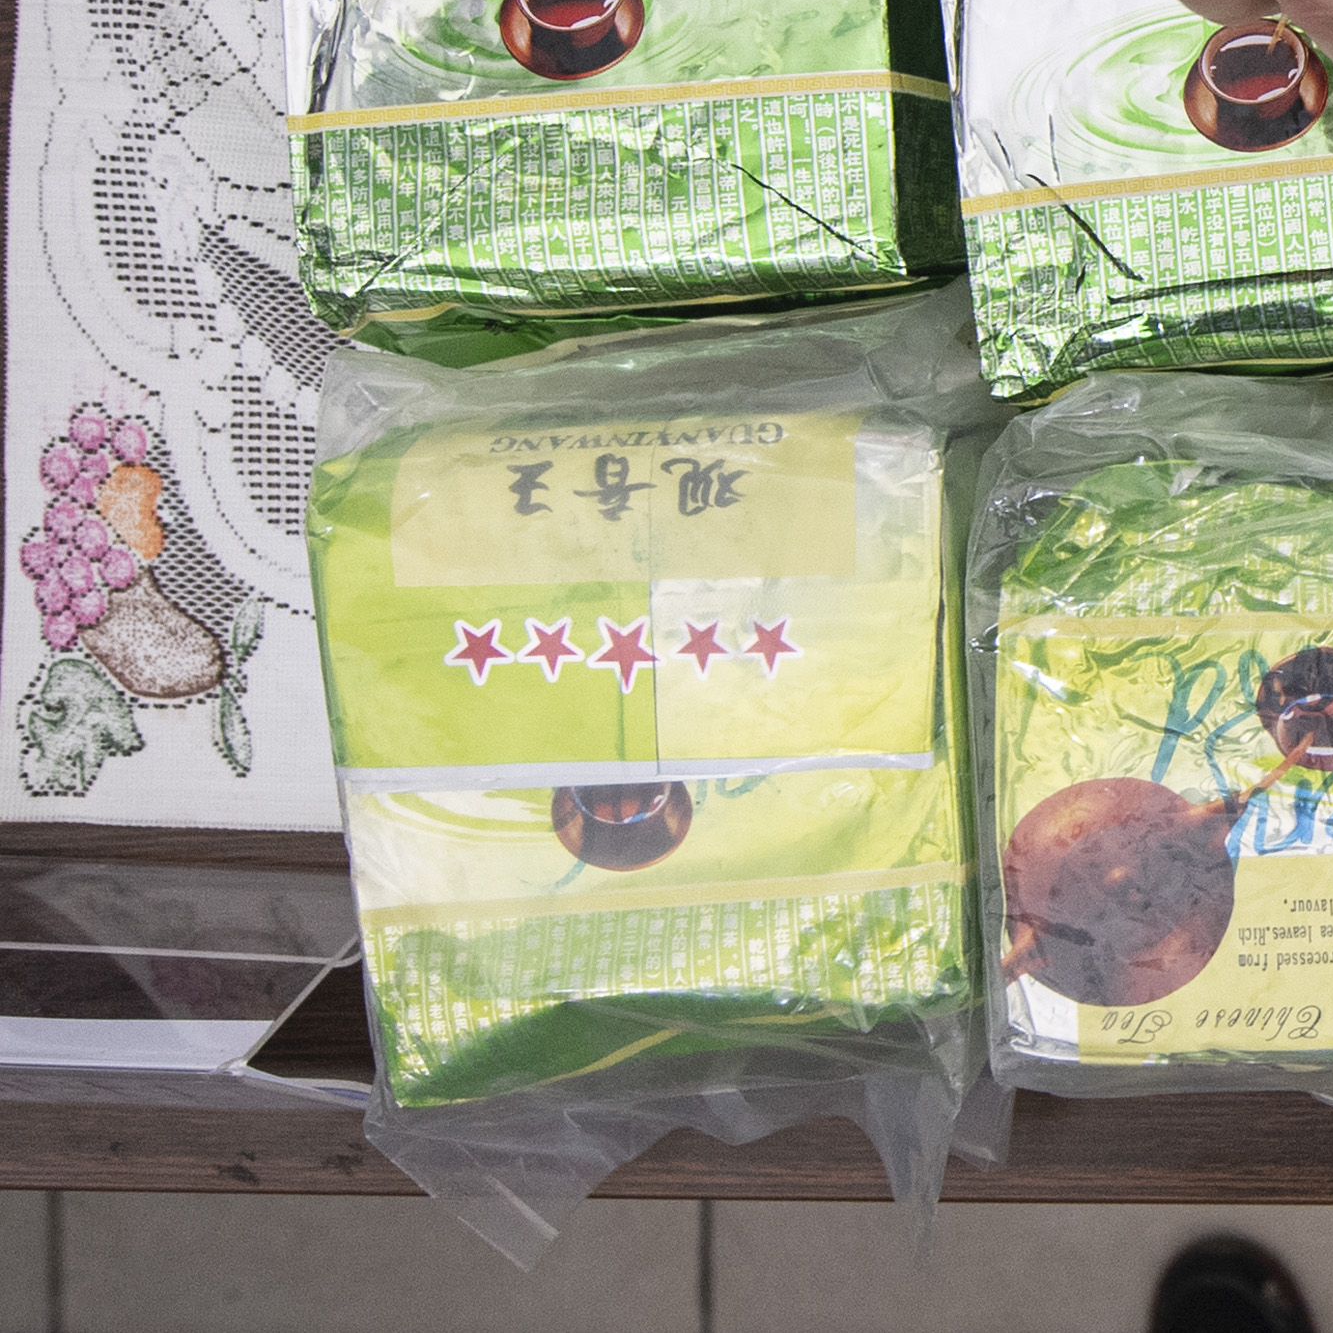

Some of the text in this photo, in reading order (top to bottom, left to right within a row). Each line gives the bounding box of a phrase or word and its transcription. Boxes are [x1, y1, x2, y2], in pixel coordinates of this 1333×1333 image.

[489, 422, 783, 454] GUANYINWANG
[507, 454, 749, 522] 观音王
[1237, 953, 1268, 971] from
[1101, 1008, 1172, 1045] Tea
